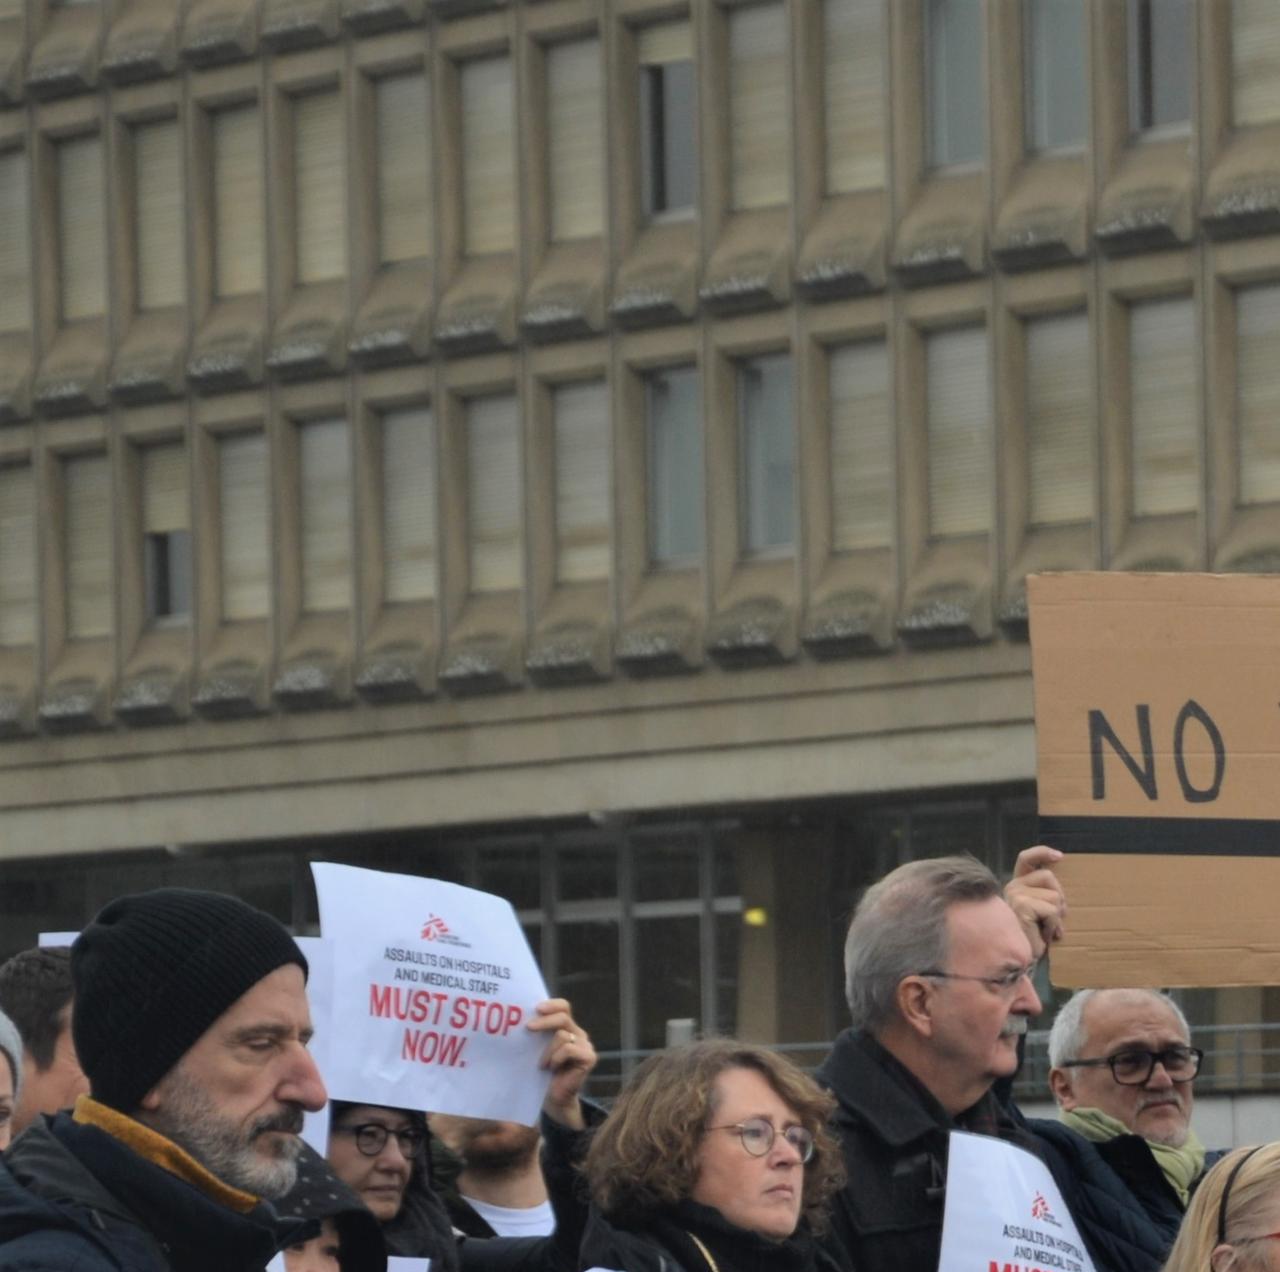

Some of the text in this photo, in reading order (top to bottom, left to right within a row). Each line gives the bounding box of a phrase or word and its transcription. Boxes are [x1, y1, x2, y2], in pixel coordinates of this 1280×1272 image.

[1087, 699, 1226, 803] NO
[384, 947, 511, 979] ASSAULTS ON HOSPITALS
[394, 967, 499, 995] AND MEDICAL STAFF
[369, 984, 522, 1036] MUST STOP
[402, 1028, 467, 1068] NOW.
[1002, 1224, 1044, 1247] ASSAULTS
[1045, 1235, 1055, 1248] ON
[1014, 1246, 1031, 1260] AND
[1033, 1248, 1066, 1270] MEDICAL
